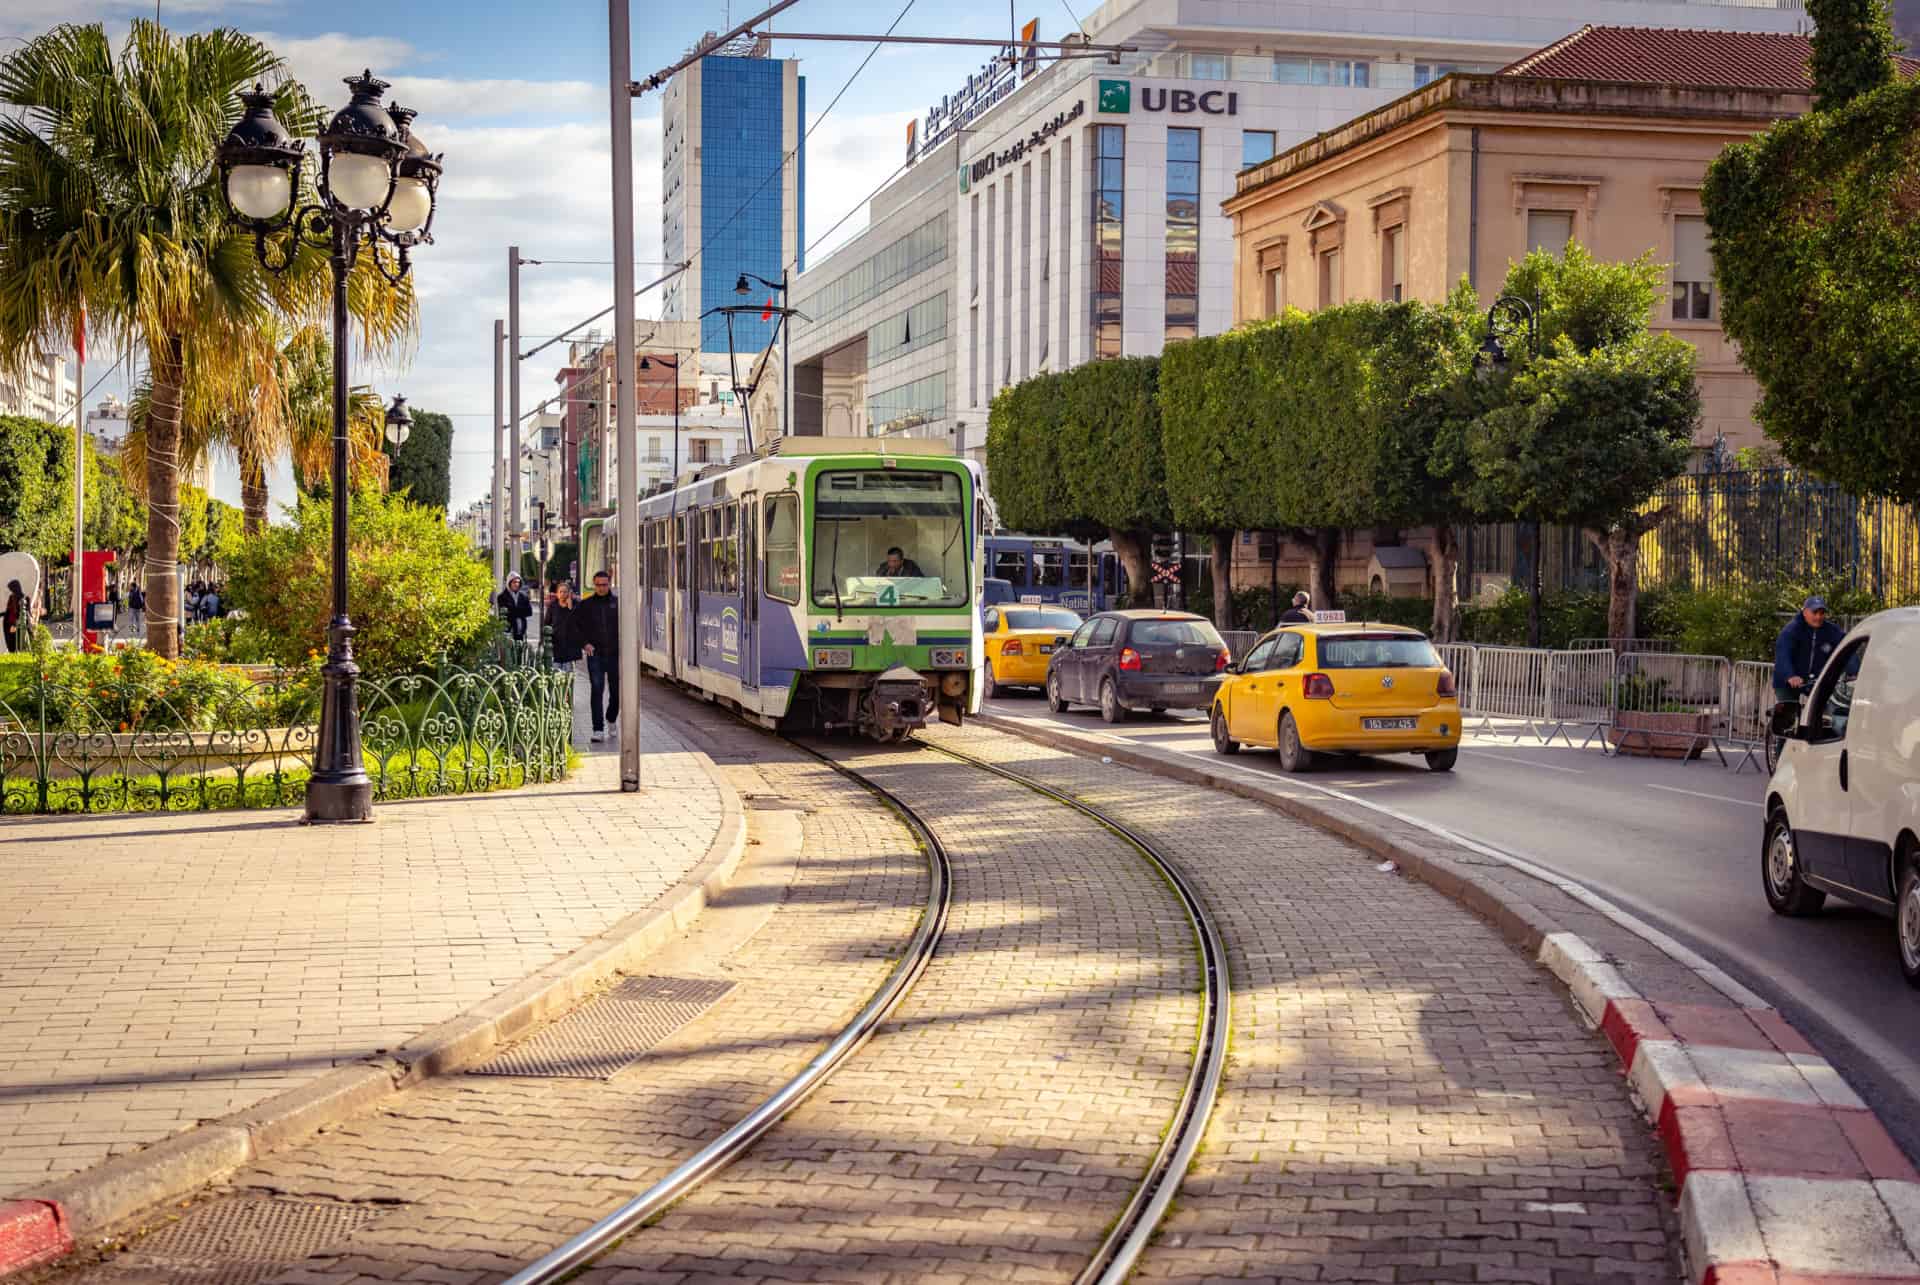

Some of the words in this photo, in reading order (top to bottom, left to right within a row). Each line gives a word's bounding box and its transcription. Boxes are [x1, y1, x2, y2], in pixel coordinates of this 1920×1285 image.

[1142, 87, 1238, 115] UBCI
[972, 152, 995, 183] UBCI
[879, 585, 897, 606] 4
[1061, 596, 1095, 609] Natilat
